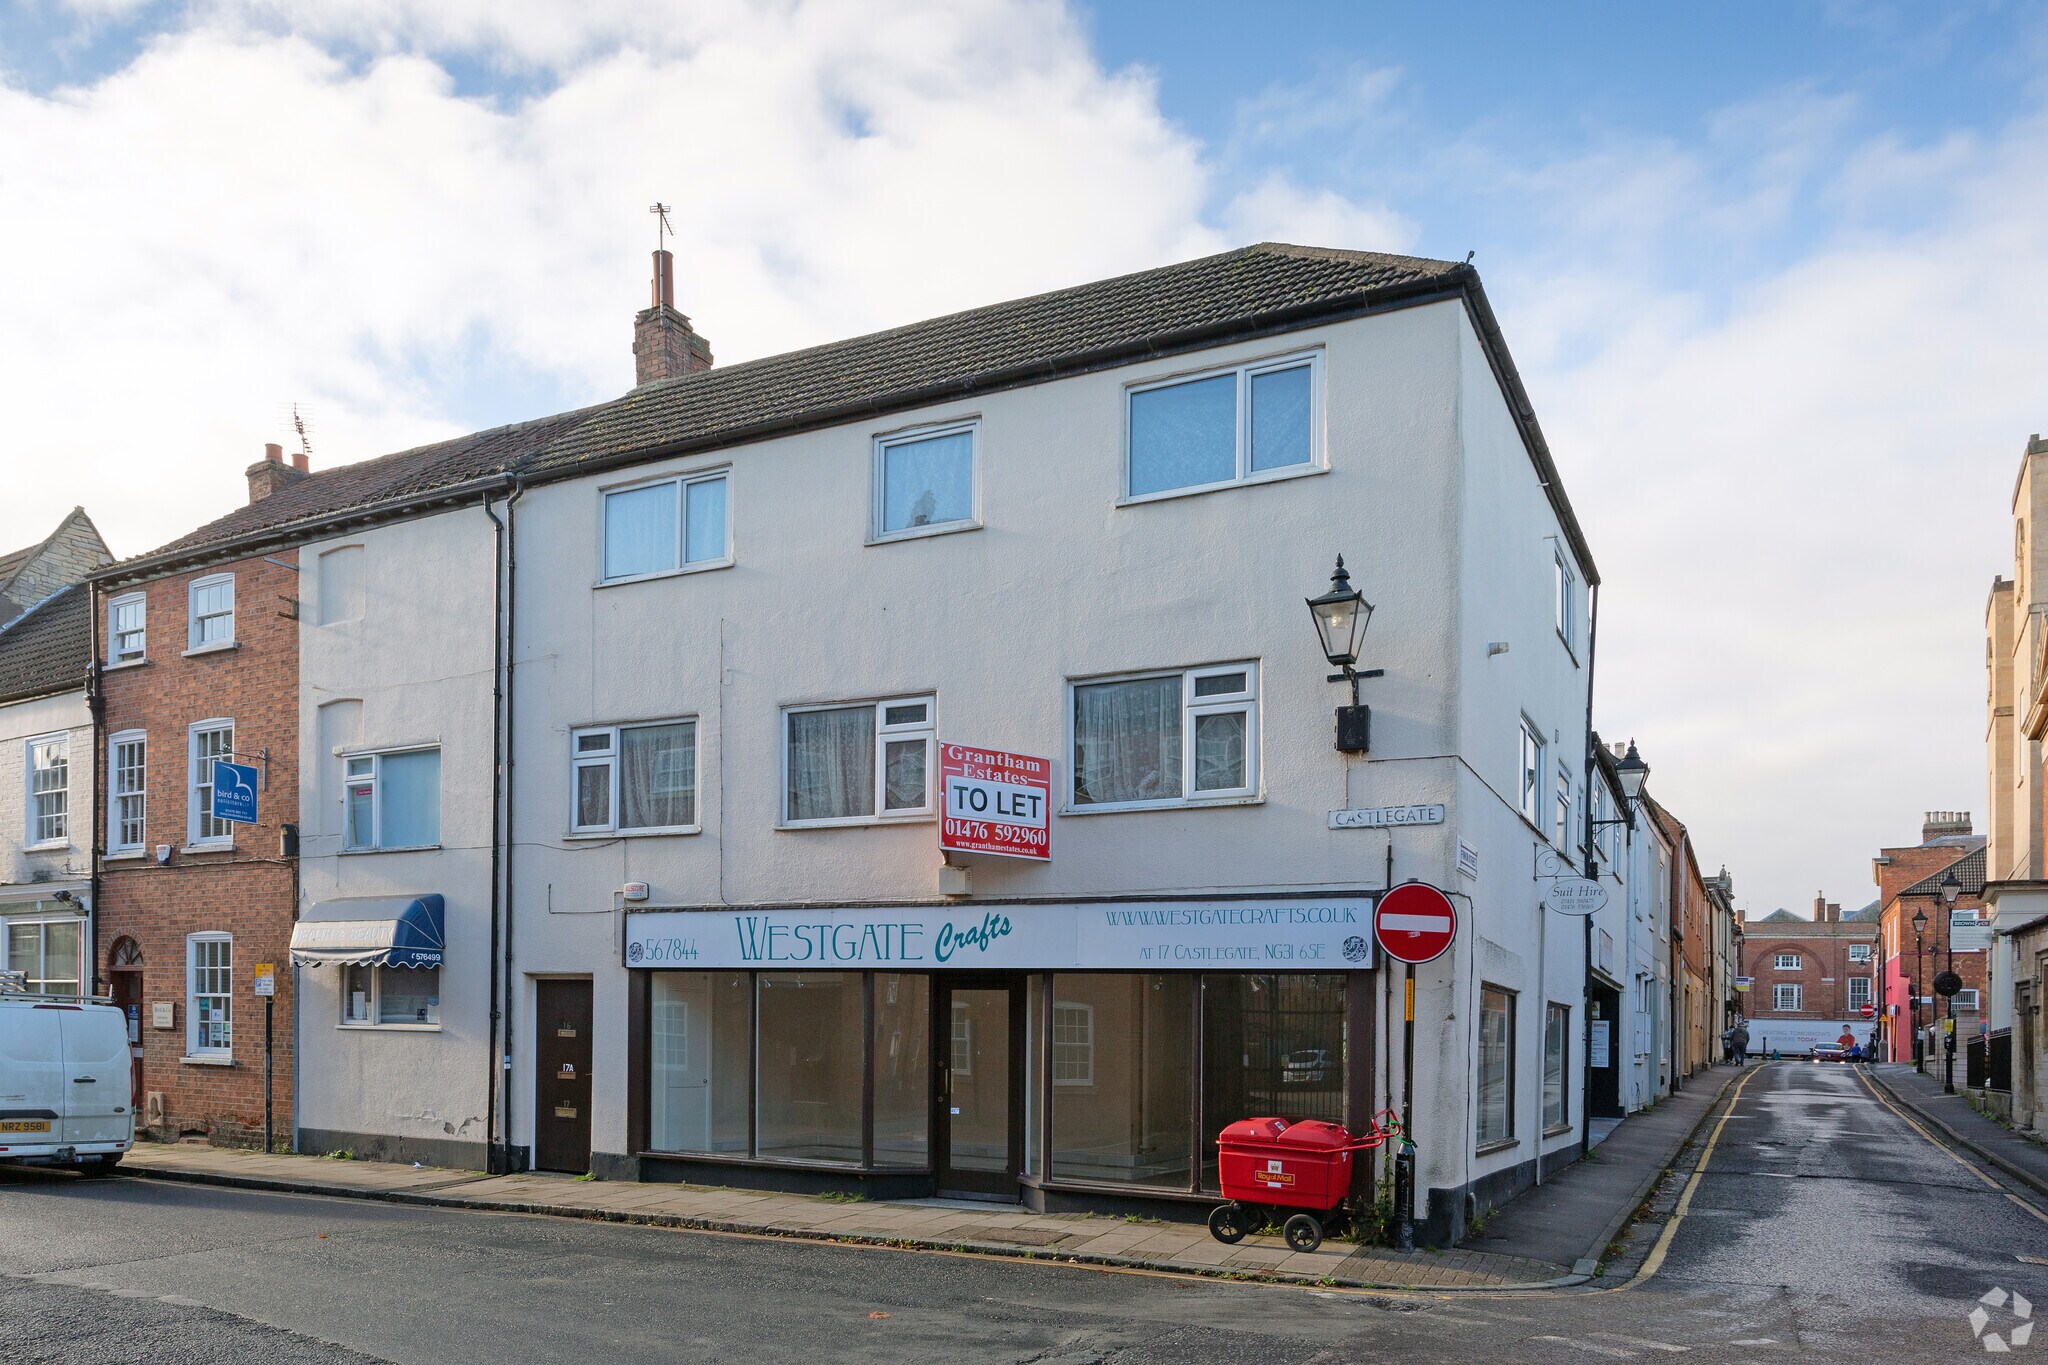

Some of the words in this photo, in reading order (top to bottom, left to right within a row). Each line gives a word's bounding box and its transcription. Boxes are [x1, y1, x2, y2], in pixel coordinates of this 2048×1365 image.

[948, 745, 1041, 772] Grantham
[962, 763, 1028, 785] Estates
[217, 789, 232, 798] bird
[953, 785, 988, 812] TO
[997, 791, 1042, 818] LET
[1335, 808, 1435, 825] CASTLEGATE
[945, 818, 988, 839] 01476
[995, 824, 1046, 846] 592960
[955, 840, 1038, 855] www.granthamestates.co.uk
[1553, 886, 1573, 897] Suit
[1578, 885, 1604, 897] Hire
[1105, 907, 1358, 926] WWW.WESTGATECRAFTS.CO.UK
[338, 928, 346, 939] &
[350, 927, 394, 941] BEAUTY
[735, 916, 924, 961] WESTGATE
[934, 911, 1013, 963] Crafts
[645, 938, 700, 960] 567844
[1158, 945, 1170, 960] 17
[1264, 944, 1295, 960] NG31
[1299, 944, 1326, 960] 6SE
[416, 953, 441, 961] 576499
[563, 1021, 572, 1030] 16
[562, 1063, 574, 1072] 17A
[563, 1099, 571, 1108] 17
[1, 1122, 21, 1131] NRZ
[23, 1121, 45, 1131] 9581
[1257, 1172, 1277, 1183] Royal
[1276, 1173, 1293, 1183] Mail
